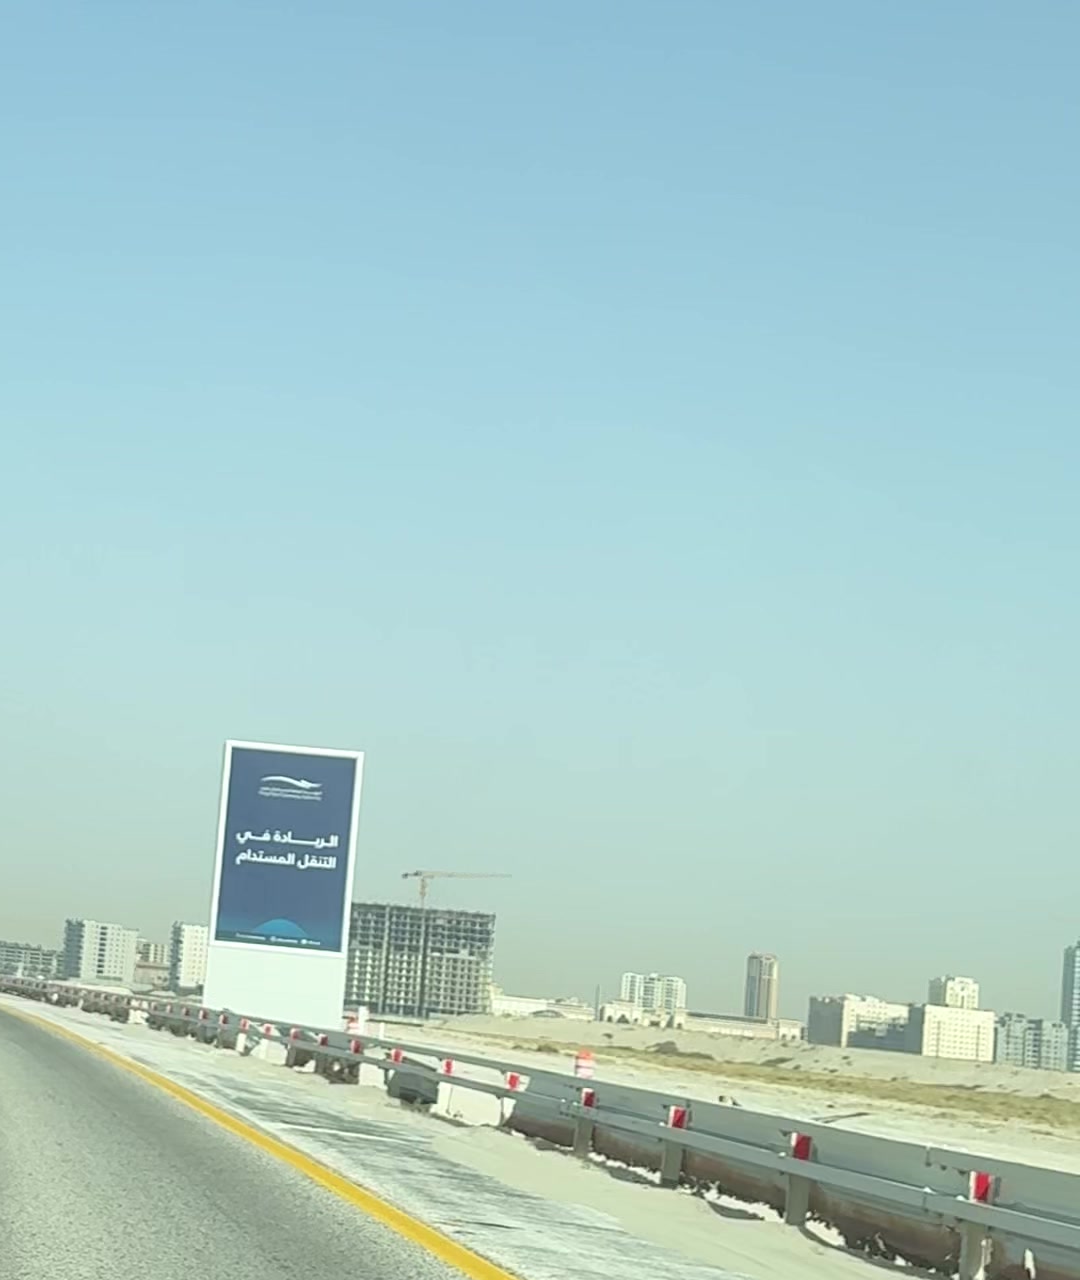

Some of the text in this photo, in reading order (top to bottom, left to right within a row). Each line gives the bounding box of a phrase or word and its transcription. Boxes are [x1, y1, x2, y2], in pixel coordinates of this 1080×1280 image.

[235, 829, 339, 849] الريادة في
[235, 848, 337, 869] التنقل المستدام
